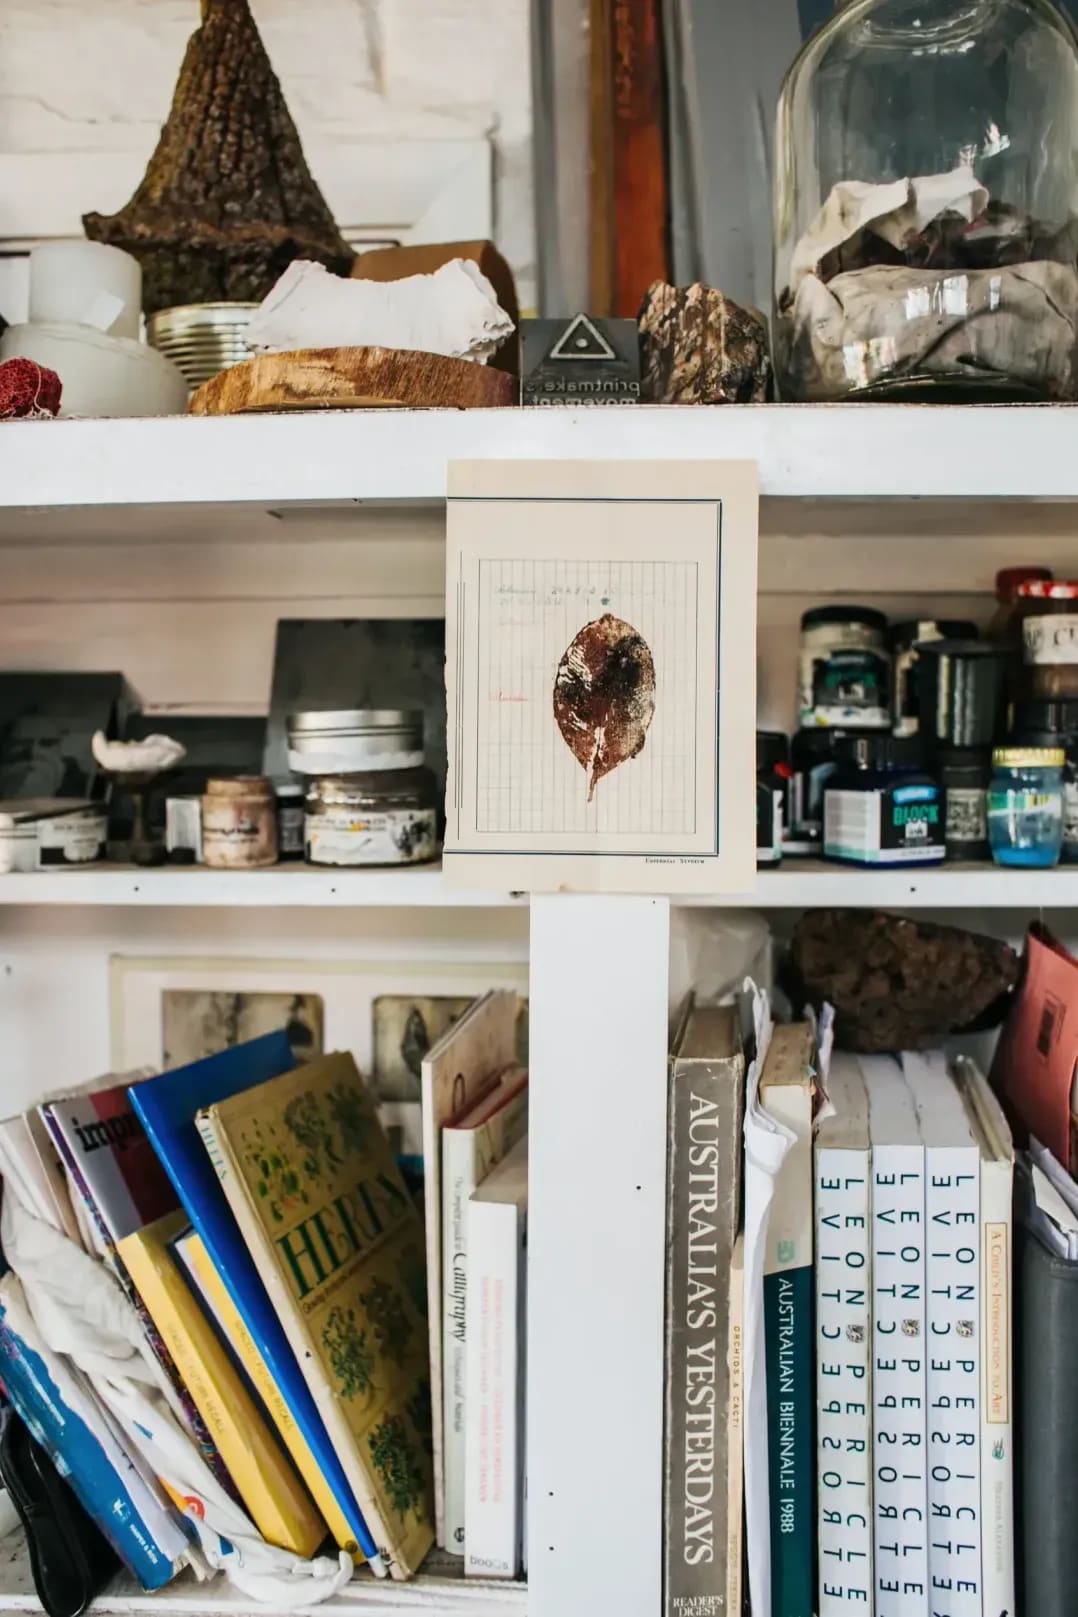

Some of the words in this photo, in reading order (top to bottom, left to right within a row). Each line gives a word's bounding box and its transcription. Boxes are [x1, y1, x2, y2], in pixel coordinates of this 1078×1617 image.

[893, 804, 938, 826] BLOCK
[686, 1092, 719, 1329] AUSTRALIA'S
[845, 1178, 865, 1305] LEON
[900, 1173, 920, 1299] LEON
[956, 1174, 976, 1300] LEON
[733, 1325, 741, 1375] ORCHIDS
[778, 1278, 795, 1393] AUSTRALIAN
[684, 1338, 716, 1565] YESTERDAYS
[779, 1402, 795, 1489] BIENNALE
[780, 1498, 795, 1533] 1988
[469, 1555, 510, 1571] boos
[673, 1595, 724, 1607] READER'S
[679, 1605, 718, 1617] DIGEST
